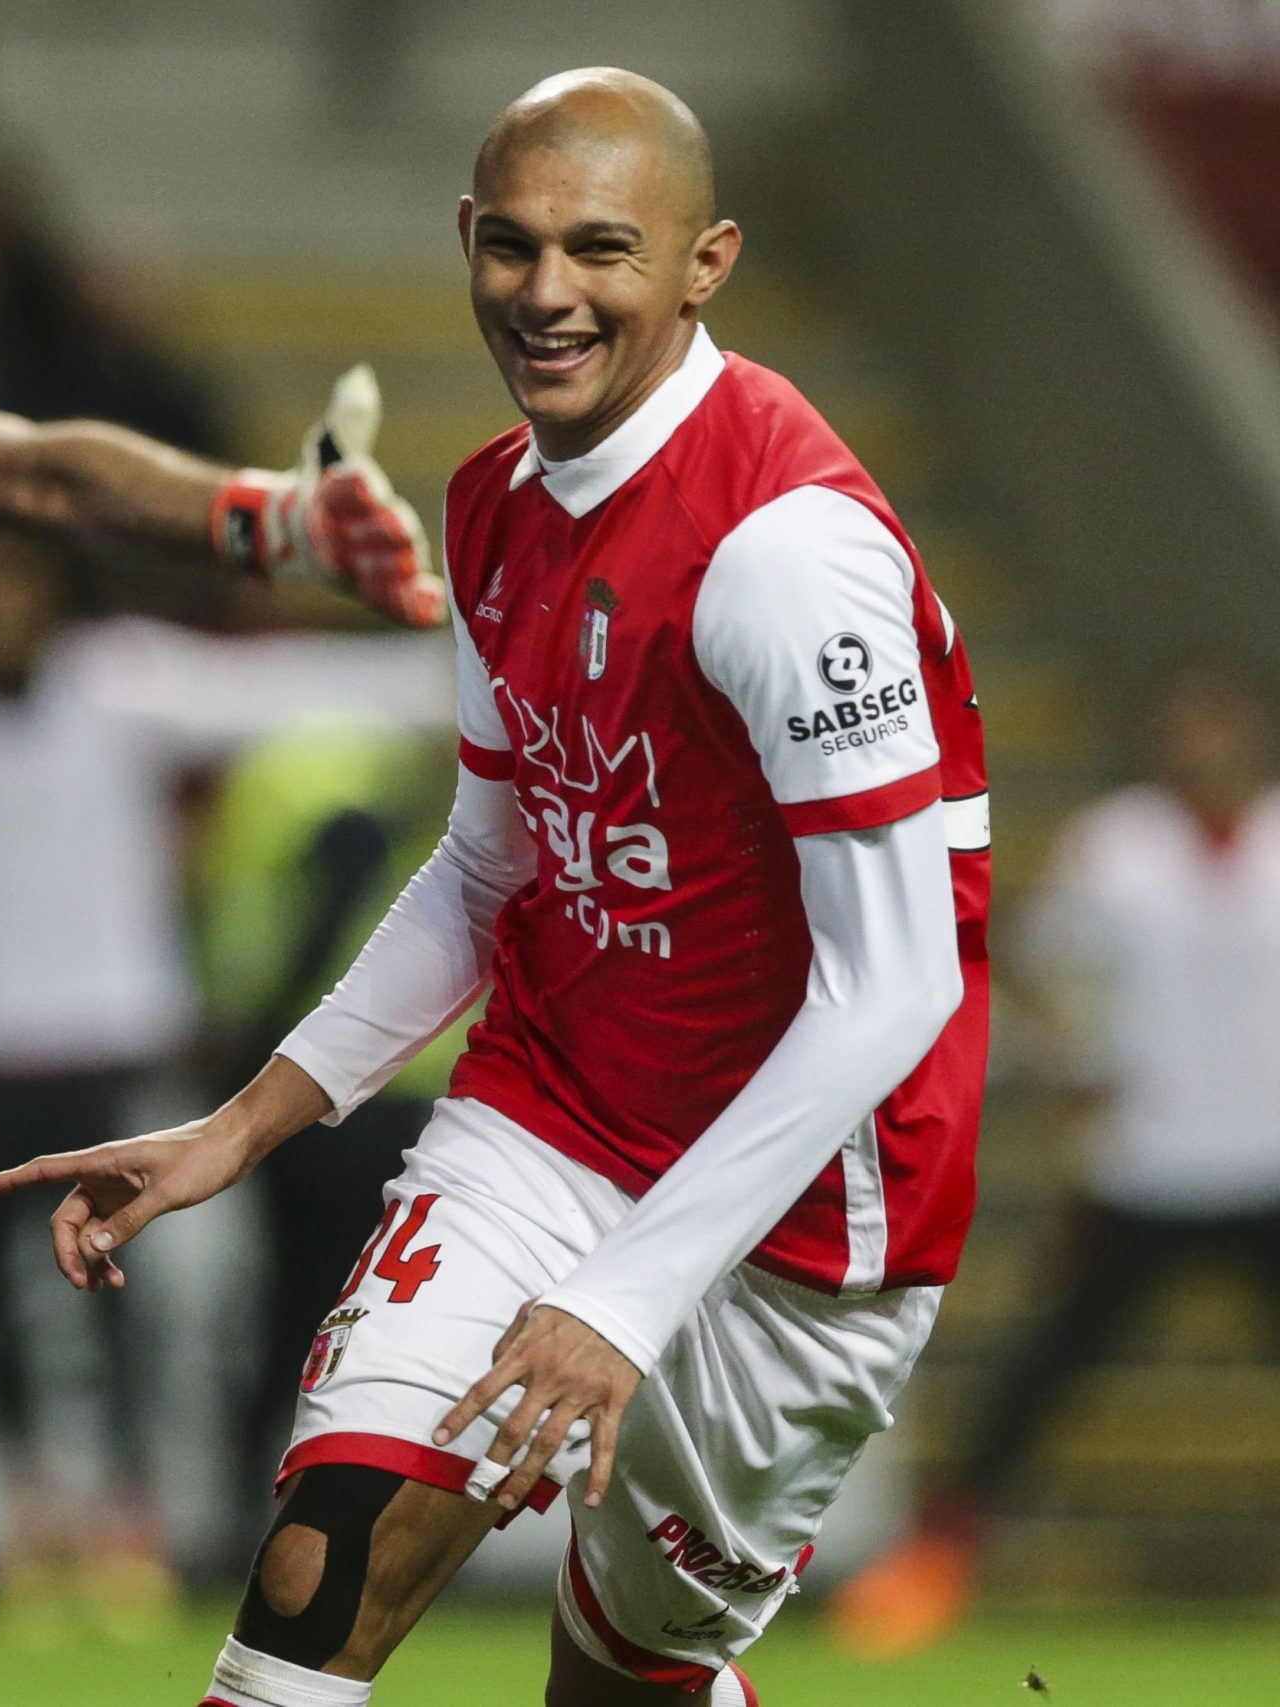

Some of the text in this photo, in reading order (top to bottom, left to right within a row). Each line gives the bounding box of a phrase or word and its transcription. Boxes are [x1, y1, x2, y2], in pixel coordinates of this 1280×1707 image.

[787, 678, 917, 742] SABSEG
[821, 715, 909, 757] SEGUROS
[564, 894, 671, 960] .com
